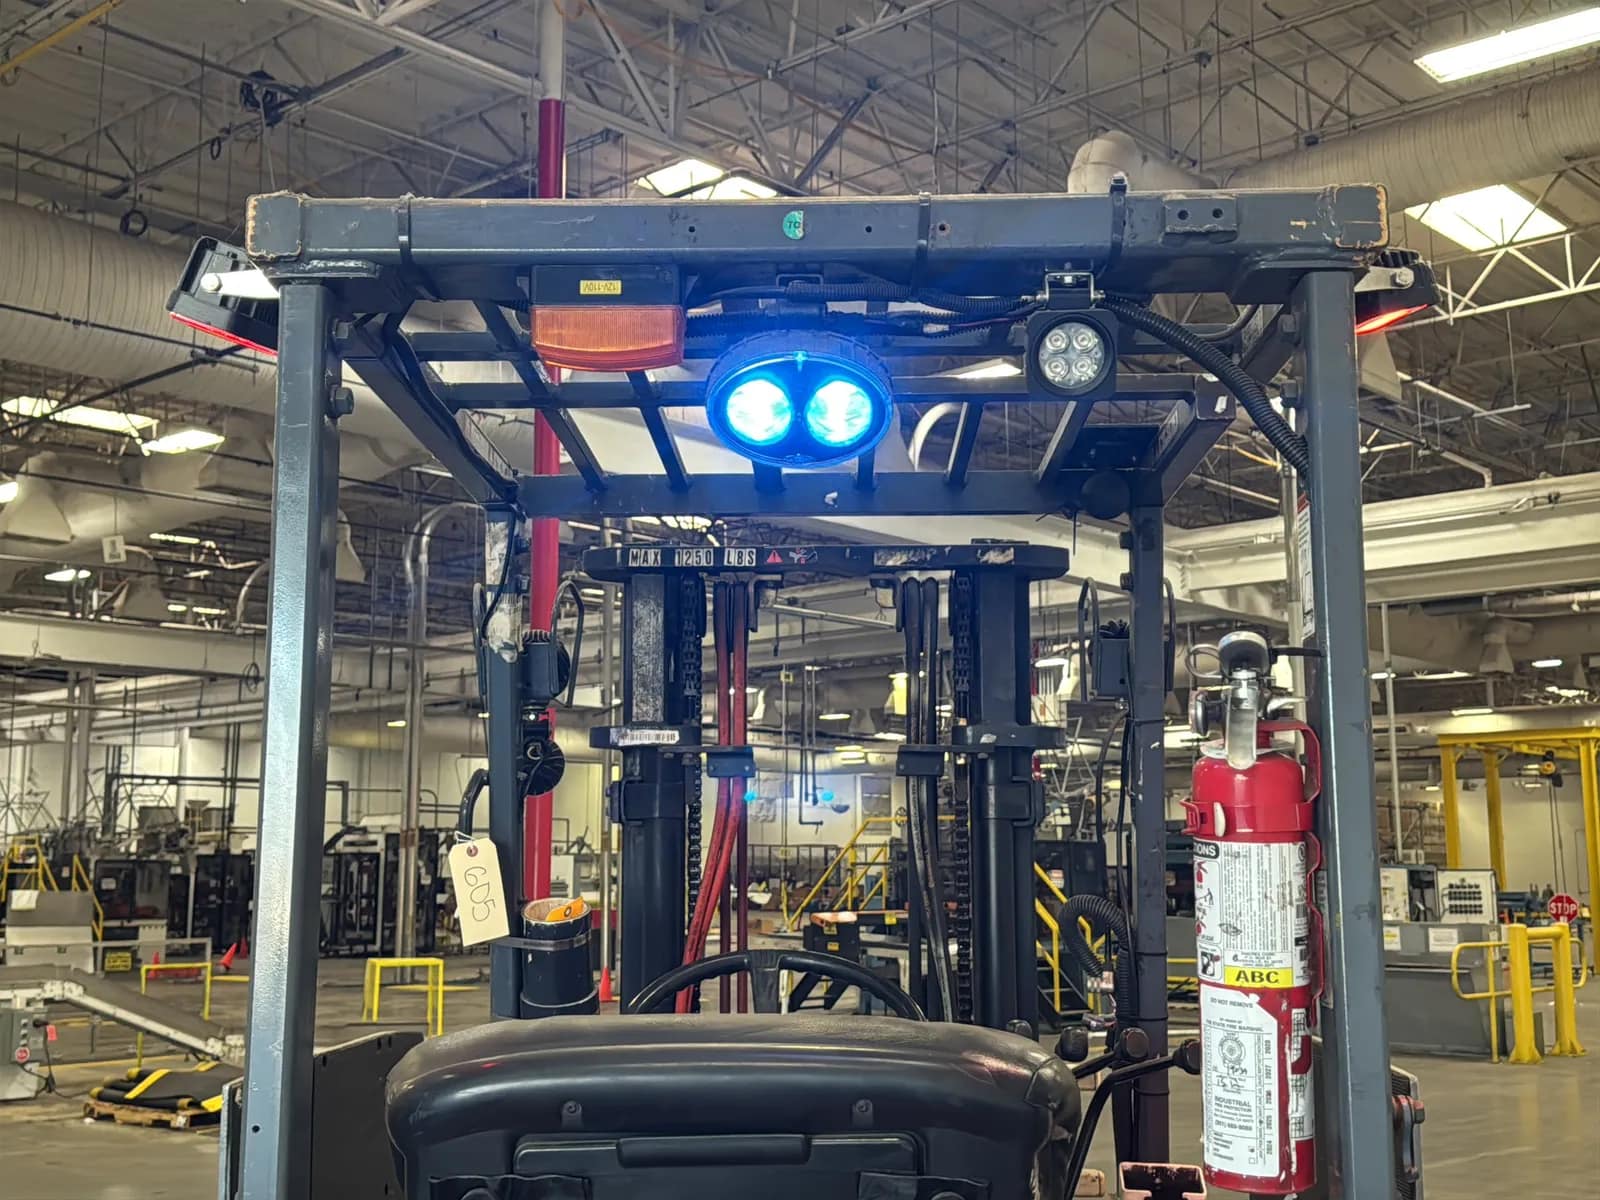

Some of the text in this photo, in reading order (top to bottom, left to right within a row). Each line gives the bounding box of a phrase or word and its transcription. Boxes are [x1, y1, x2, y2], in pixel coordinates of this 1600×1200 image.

[630, 549, 661, 566] MAX
[676, 549, 713, 566] 1250
[464, 866, 496, 922] 605
[1550, 903, 1577, 914] STOP
[1235, 970, 1280, 984] ABC
[1218, 998, 1228, 1006] NOT
[1229, 1000, 1253, 1008] REMOVE
[1214, 1095, 1252, 1107] INDUSTRIAL
